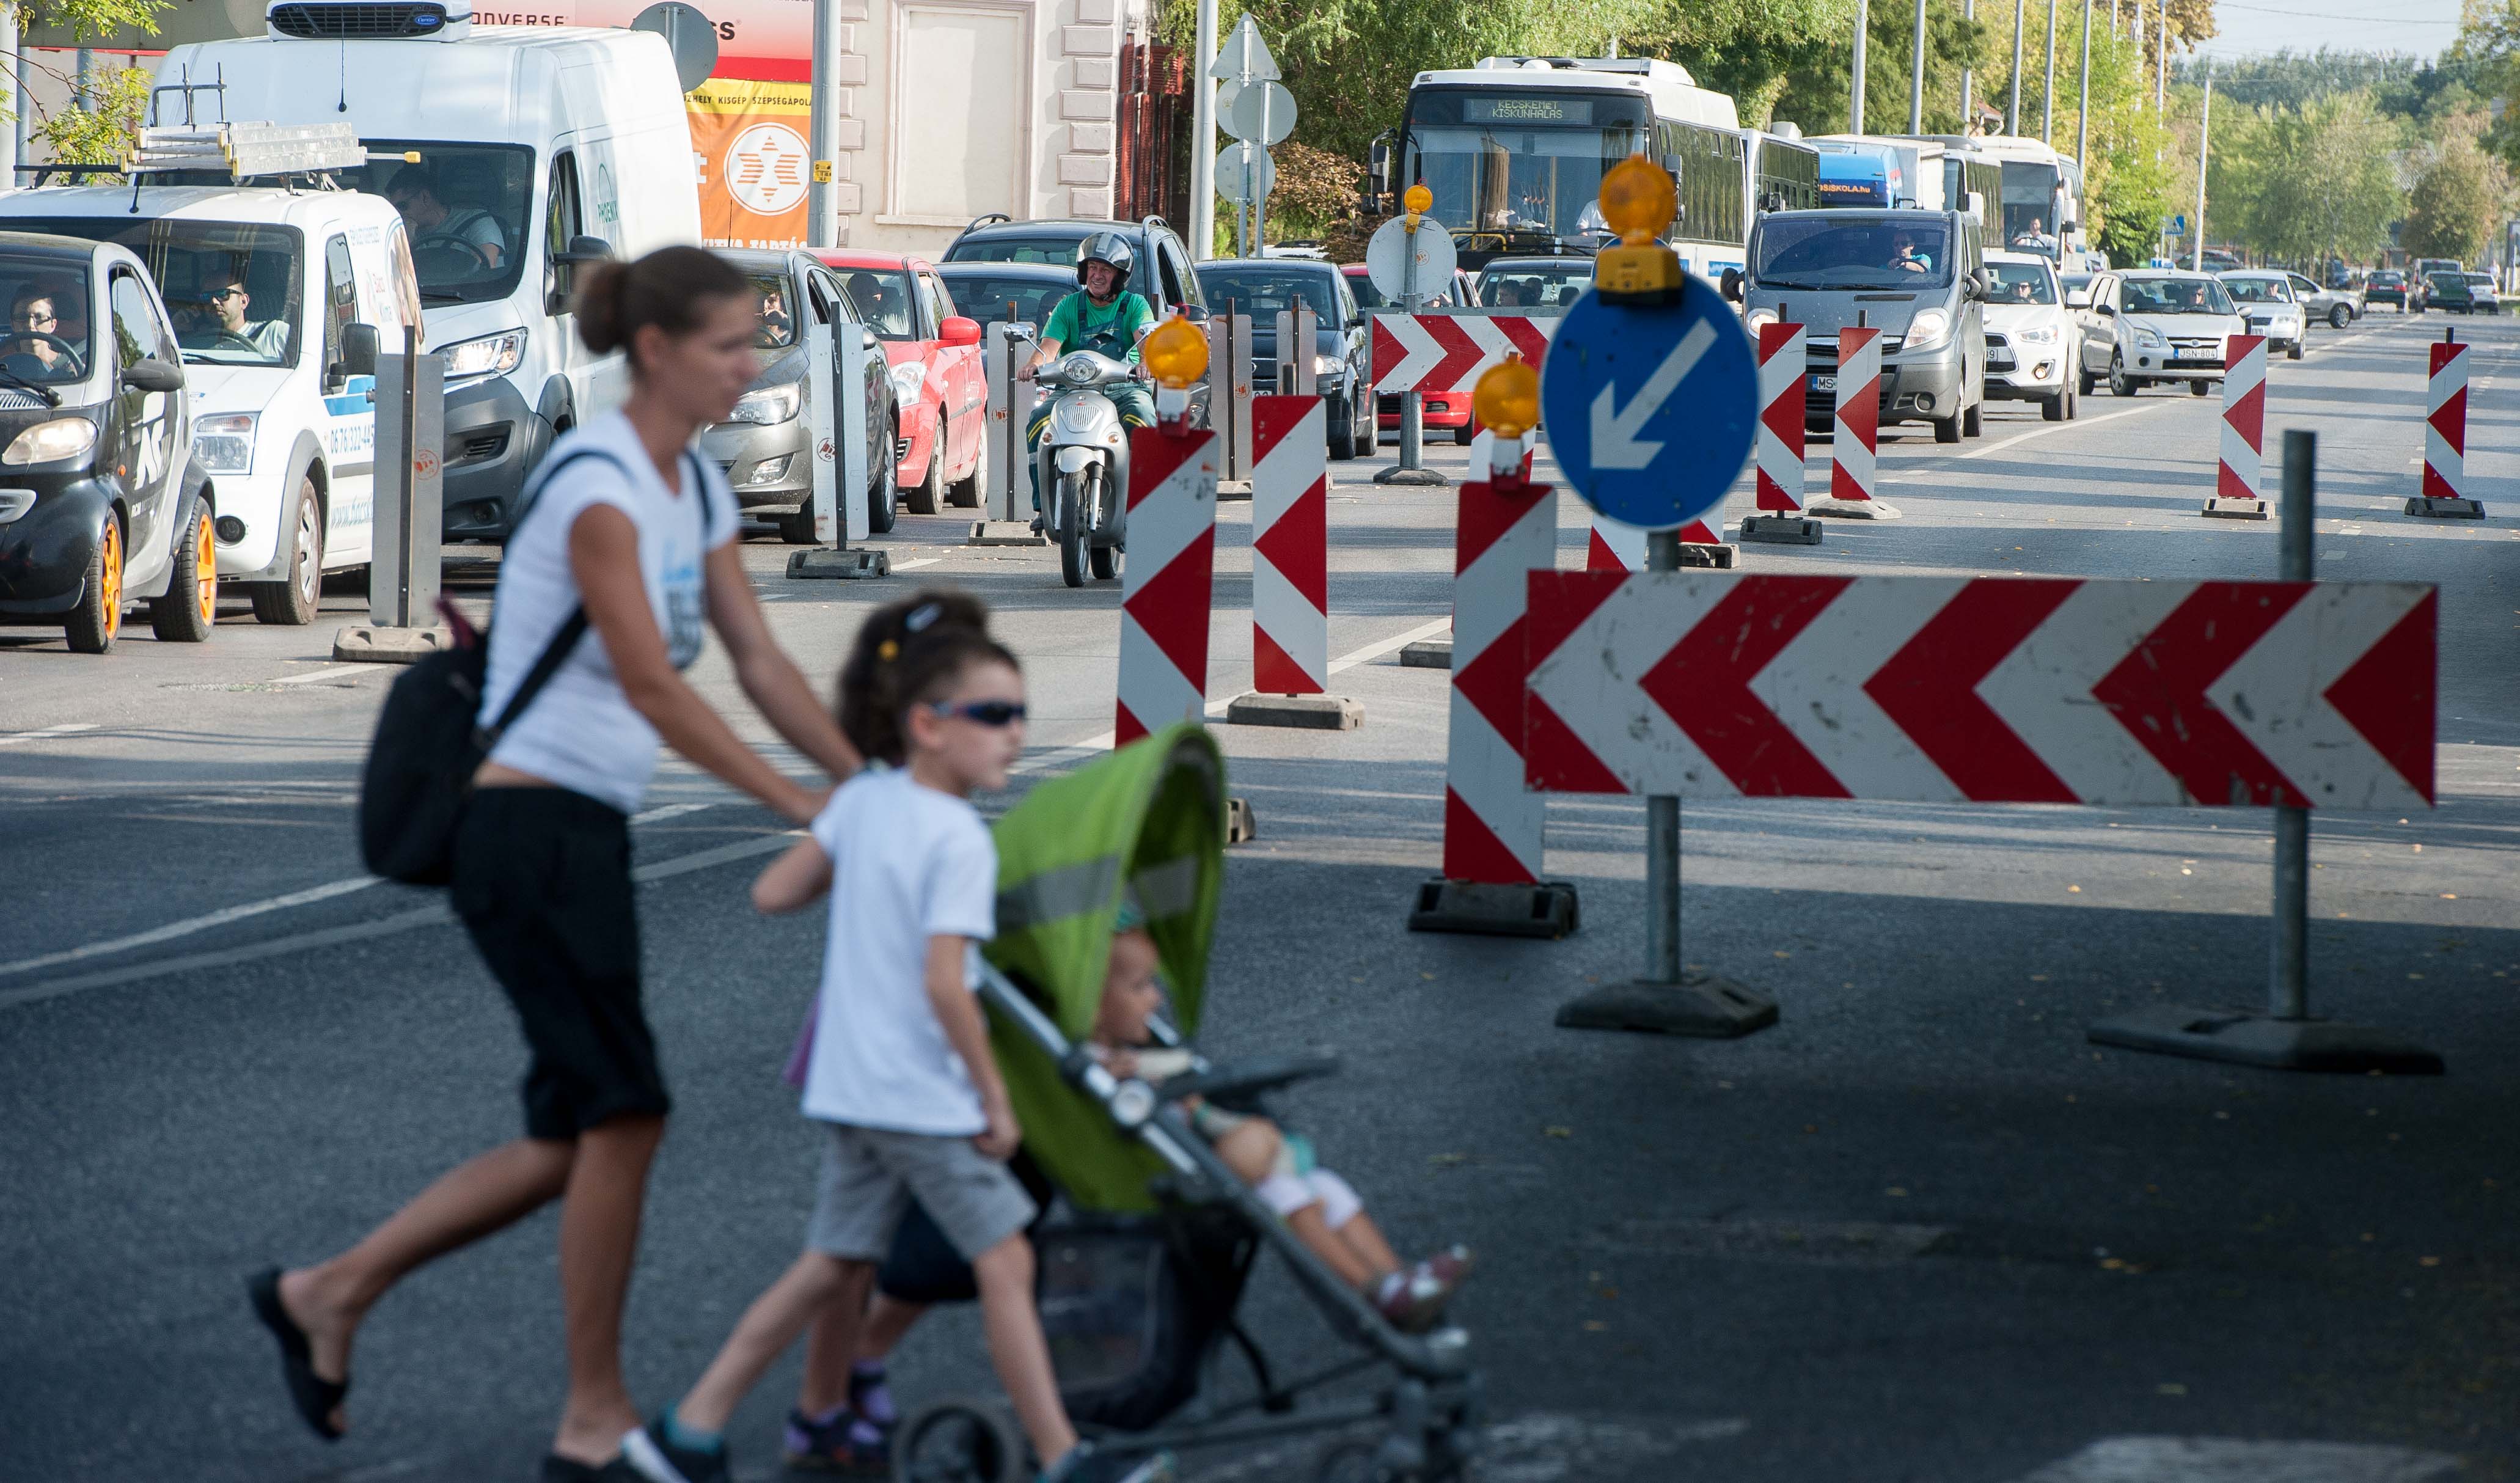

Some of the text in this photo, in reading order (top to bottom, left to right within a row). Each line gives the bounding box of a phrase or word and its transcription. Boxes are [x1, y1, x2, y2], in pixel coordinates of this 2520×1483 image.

[718, 95, 747, 104] KISGÉP
[1492, 108, 1564, 119] KISKUNHALAS
[597, 200, 618, 224] PHOENIX
